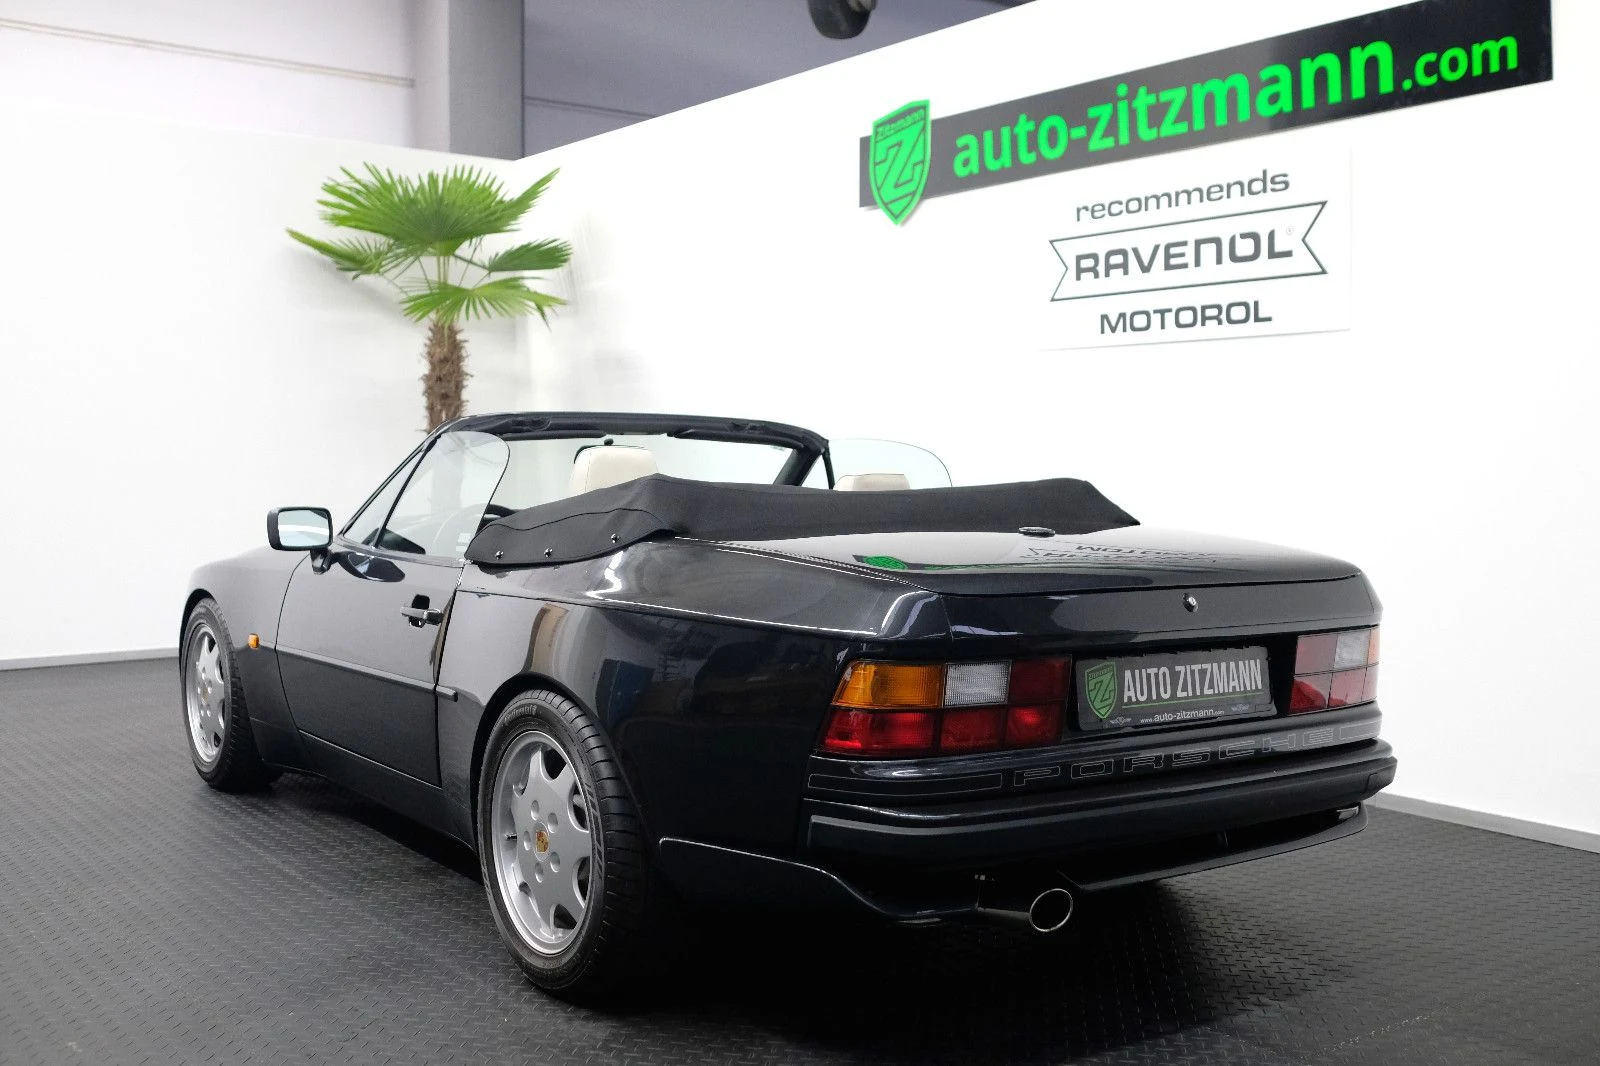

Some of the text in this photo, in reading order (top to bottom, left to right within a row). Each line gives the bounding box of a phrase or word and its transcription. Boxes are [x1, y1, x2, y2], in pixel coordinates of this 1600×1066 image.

[952, 36, 1519, 178] auto-zitzmann.com
[1076, 168, 1291, 222] recommends
[1075, 229, 1294, 282] RAVENOL
[1099, 299, 1273, 335] MOTOROL
[1123, 659, 1263, 703] AUTO ZITZMANN
[1140, 708, 1225, 724] www.auto-zitzmann.com
[1013, 727, 1334, 787] PORSCHE
